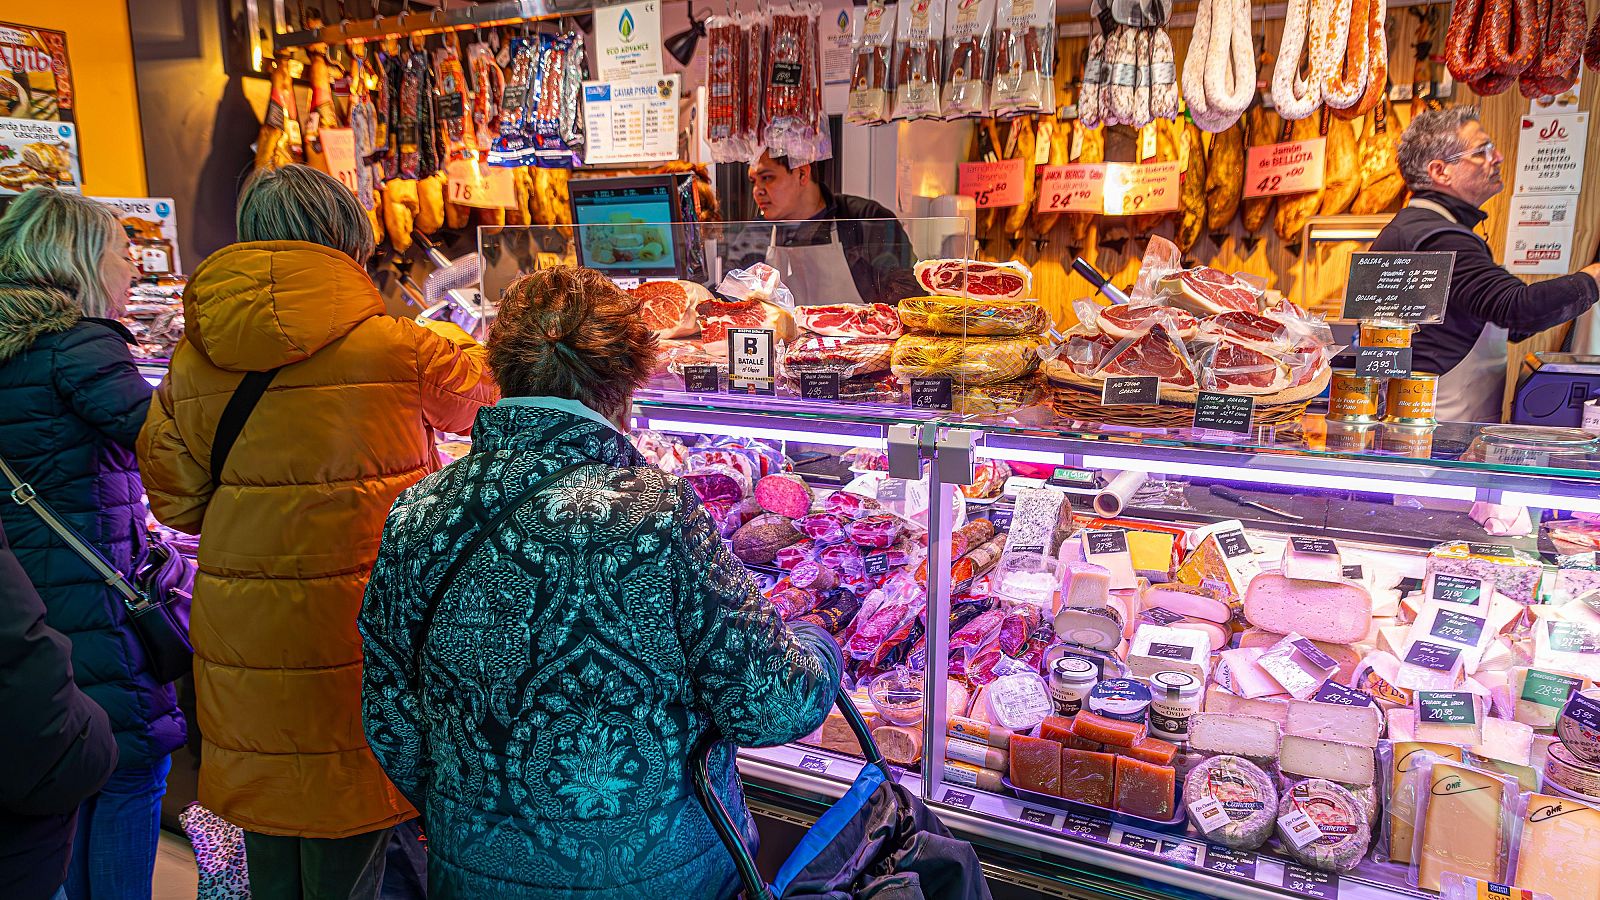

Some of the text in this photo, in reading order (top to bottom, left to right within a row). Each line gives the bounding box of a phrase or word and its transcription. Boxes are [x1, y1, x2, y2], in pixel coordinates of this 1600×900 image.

[621, 42, 649, 53] ADVANCE
[614, 86, 634, 98] CAVIAR
[1539, 118, 1569, 139] ele
[1537, 147, 1567, 156] MEJOR
[1259, 151, 1314, 168] de BELLOTA
[1530, 155, 1571, 163] CHORIZO
[1524, 162, 1577, 172] DEL MUNDO
[1537, 171, 1560, 179] 2023
[1358, 257, 1382, 265] BOLSAS
[744, 337, 759, 354] B
[738, 357, 765, 366] BATALLÉ
[1429, 708, 1455, 720] 20,95
